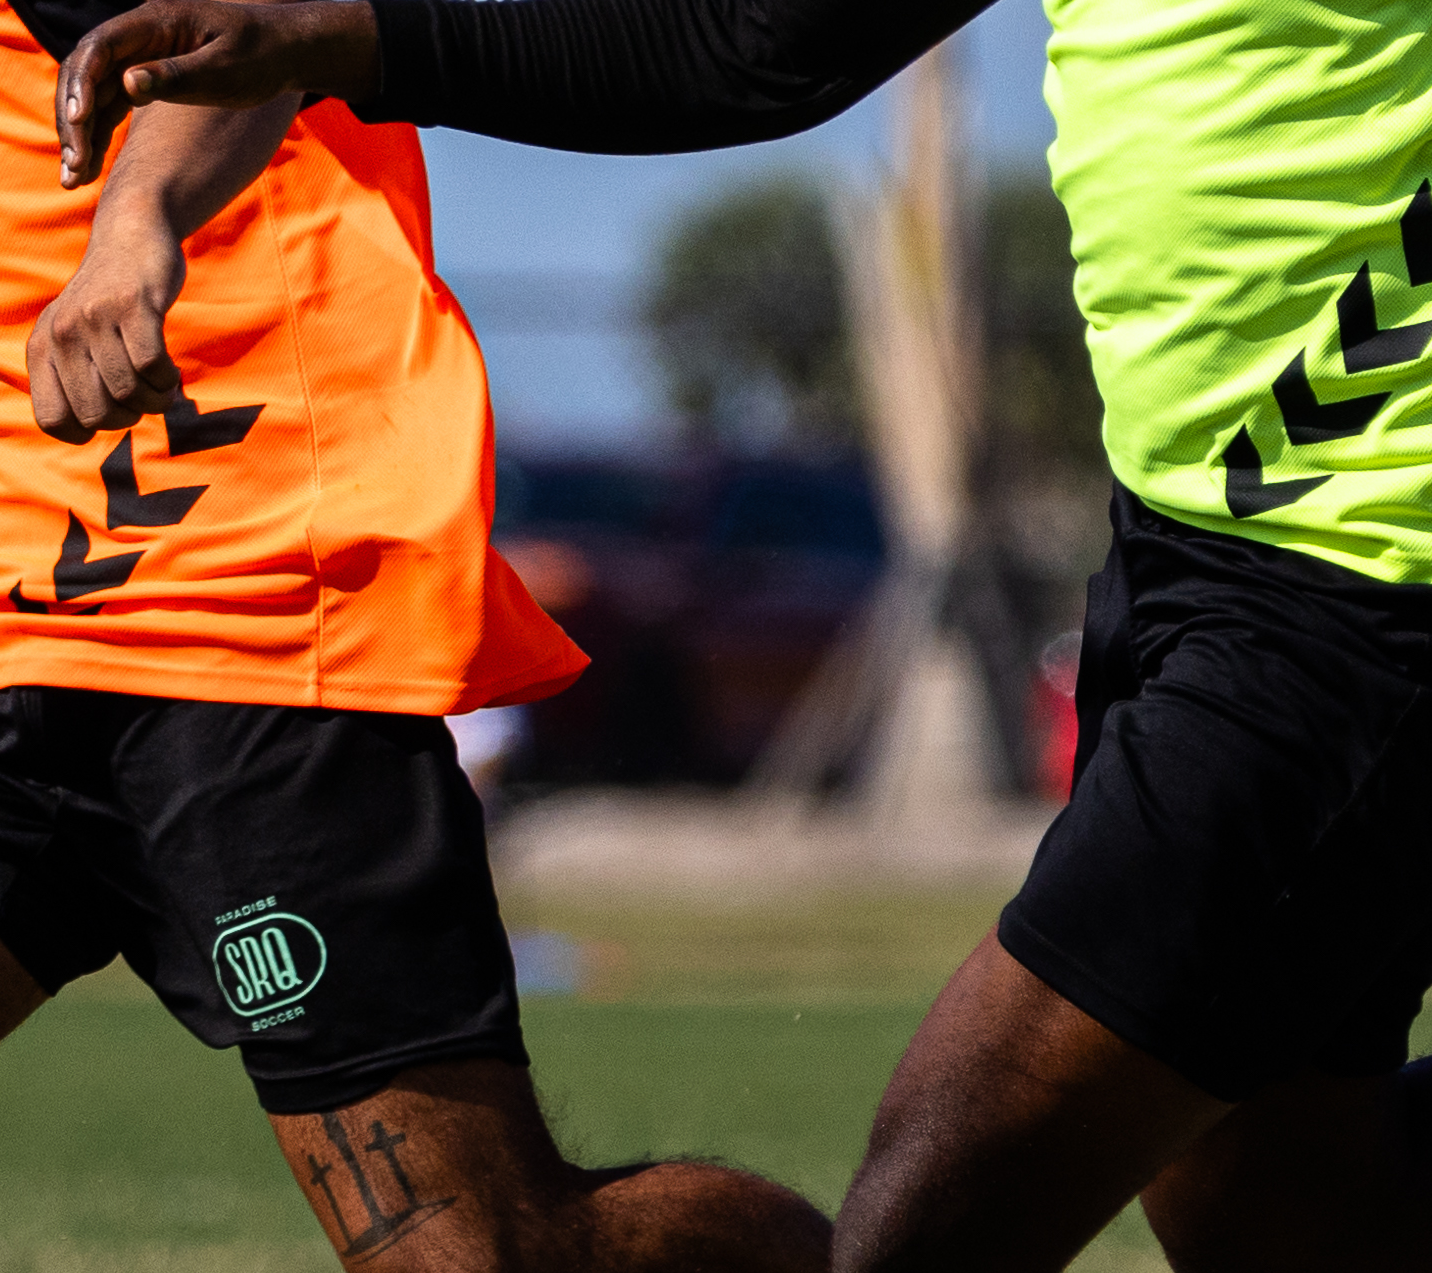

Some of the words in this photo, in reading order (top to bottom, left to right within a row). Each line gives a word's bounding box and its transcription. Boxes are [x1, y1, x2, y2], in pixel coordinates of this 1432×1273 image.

[215, 895, 278, 926] PARADISE
[224, 927, 303, 1005] SRQ
[251, 1006, 306, 1032] SOCCER
